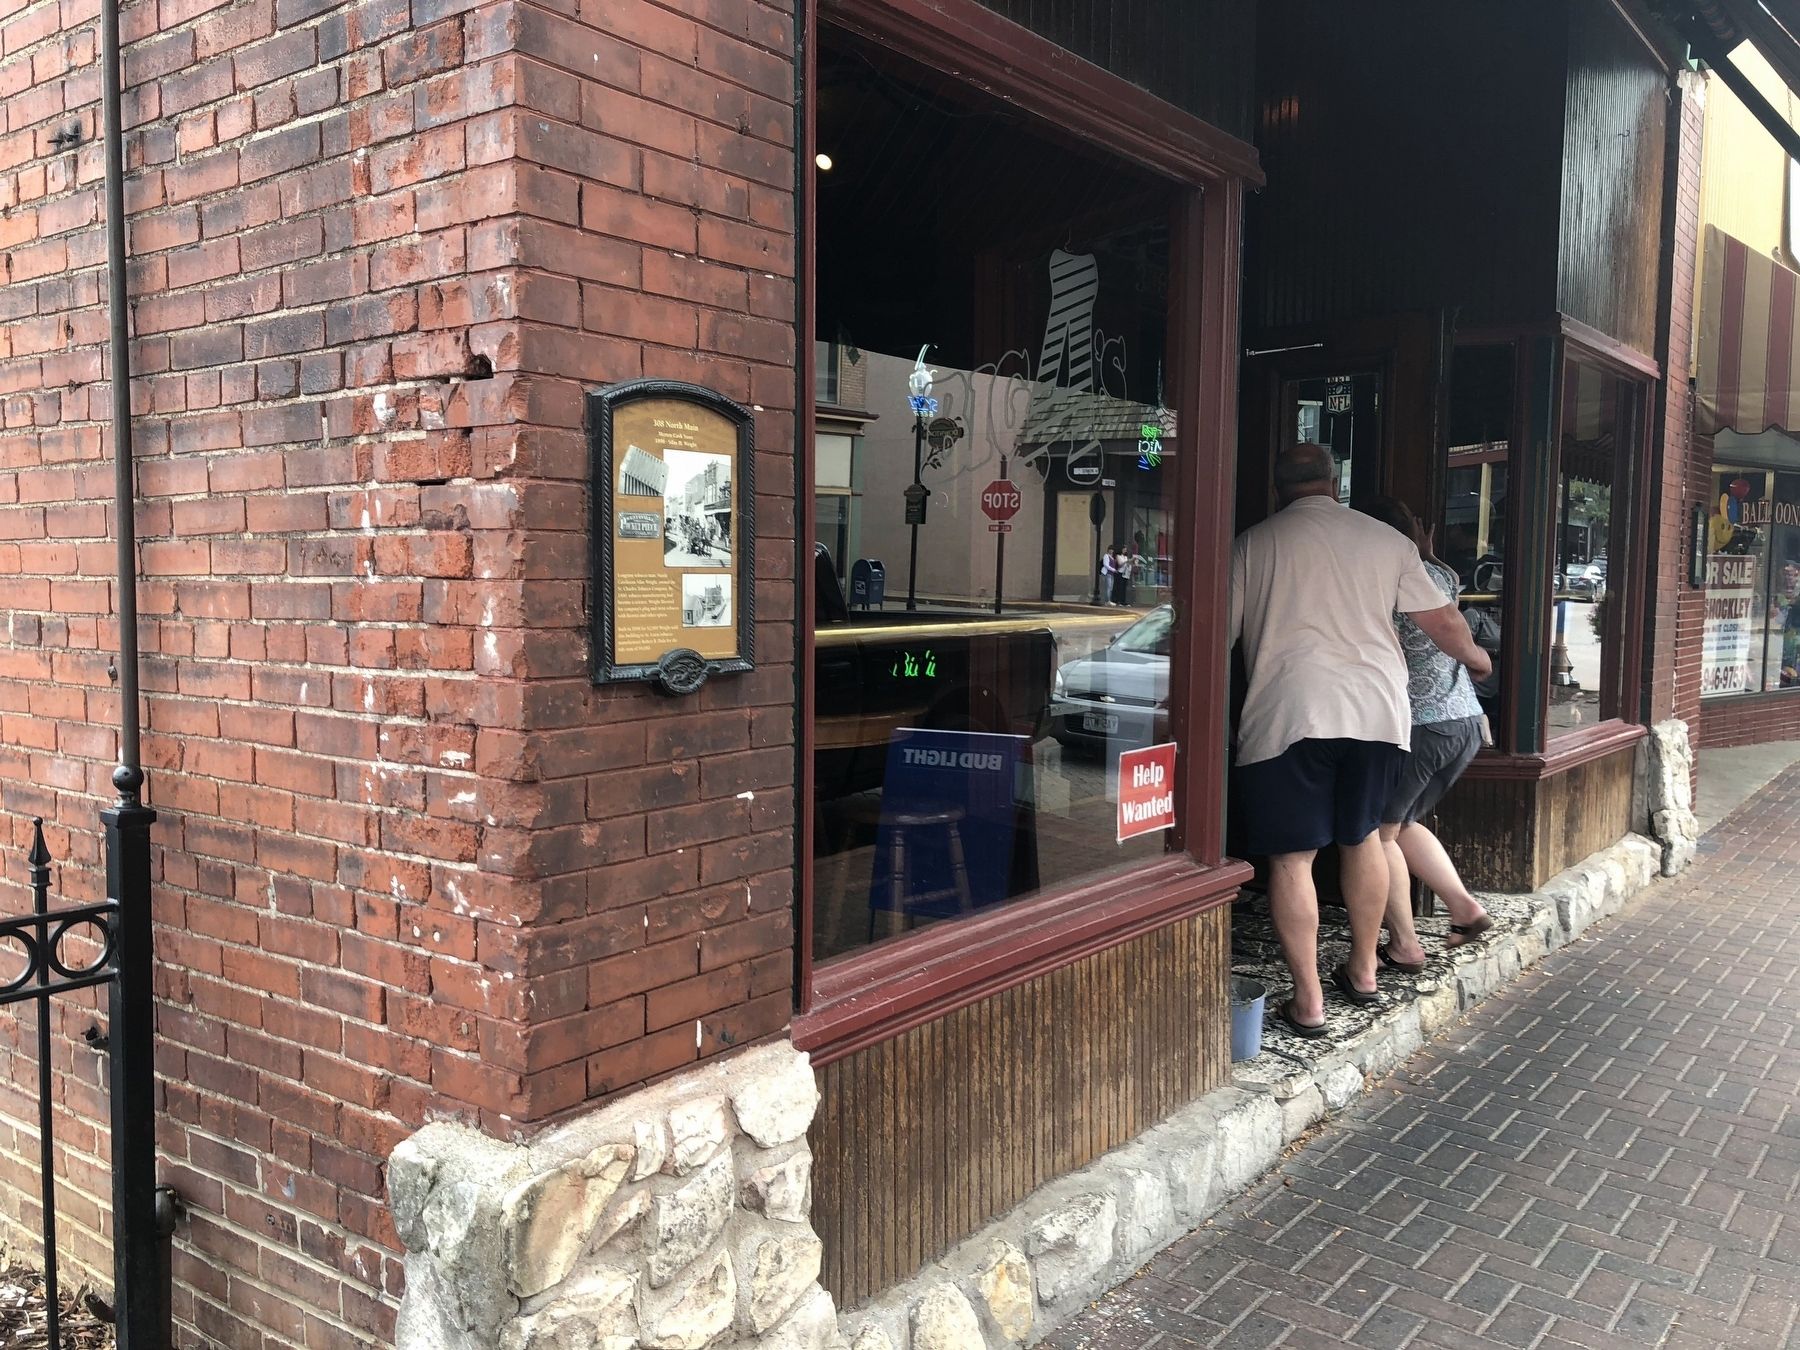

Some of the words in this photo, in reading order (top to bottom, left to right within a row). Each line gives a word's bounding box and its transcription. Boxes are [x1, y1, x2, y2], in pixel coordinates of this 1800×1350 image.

[1329, 395, 1350, 411] NFL
[684, 422, 699, 432] Main
[1722, 561, 1753, 585] SALE
[1704, 597, 1751, 620] SHOCKLEY
[1133, 761, 1164, 788] Help
[1122, 791, 1173, 825] Wanted
